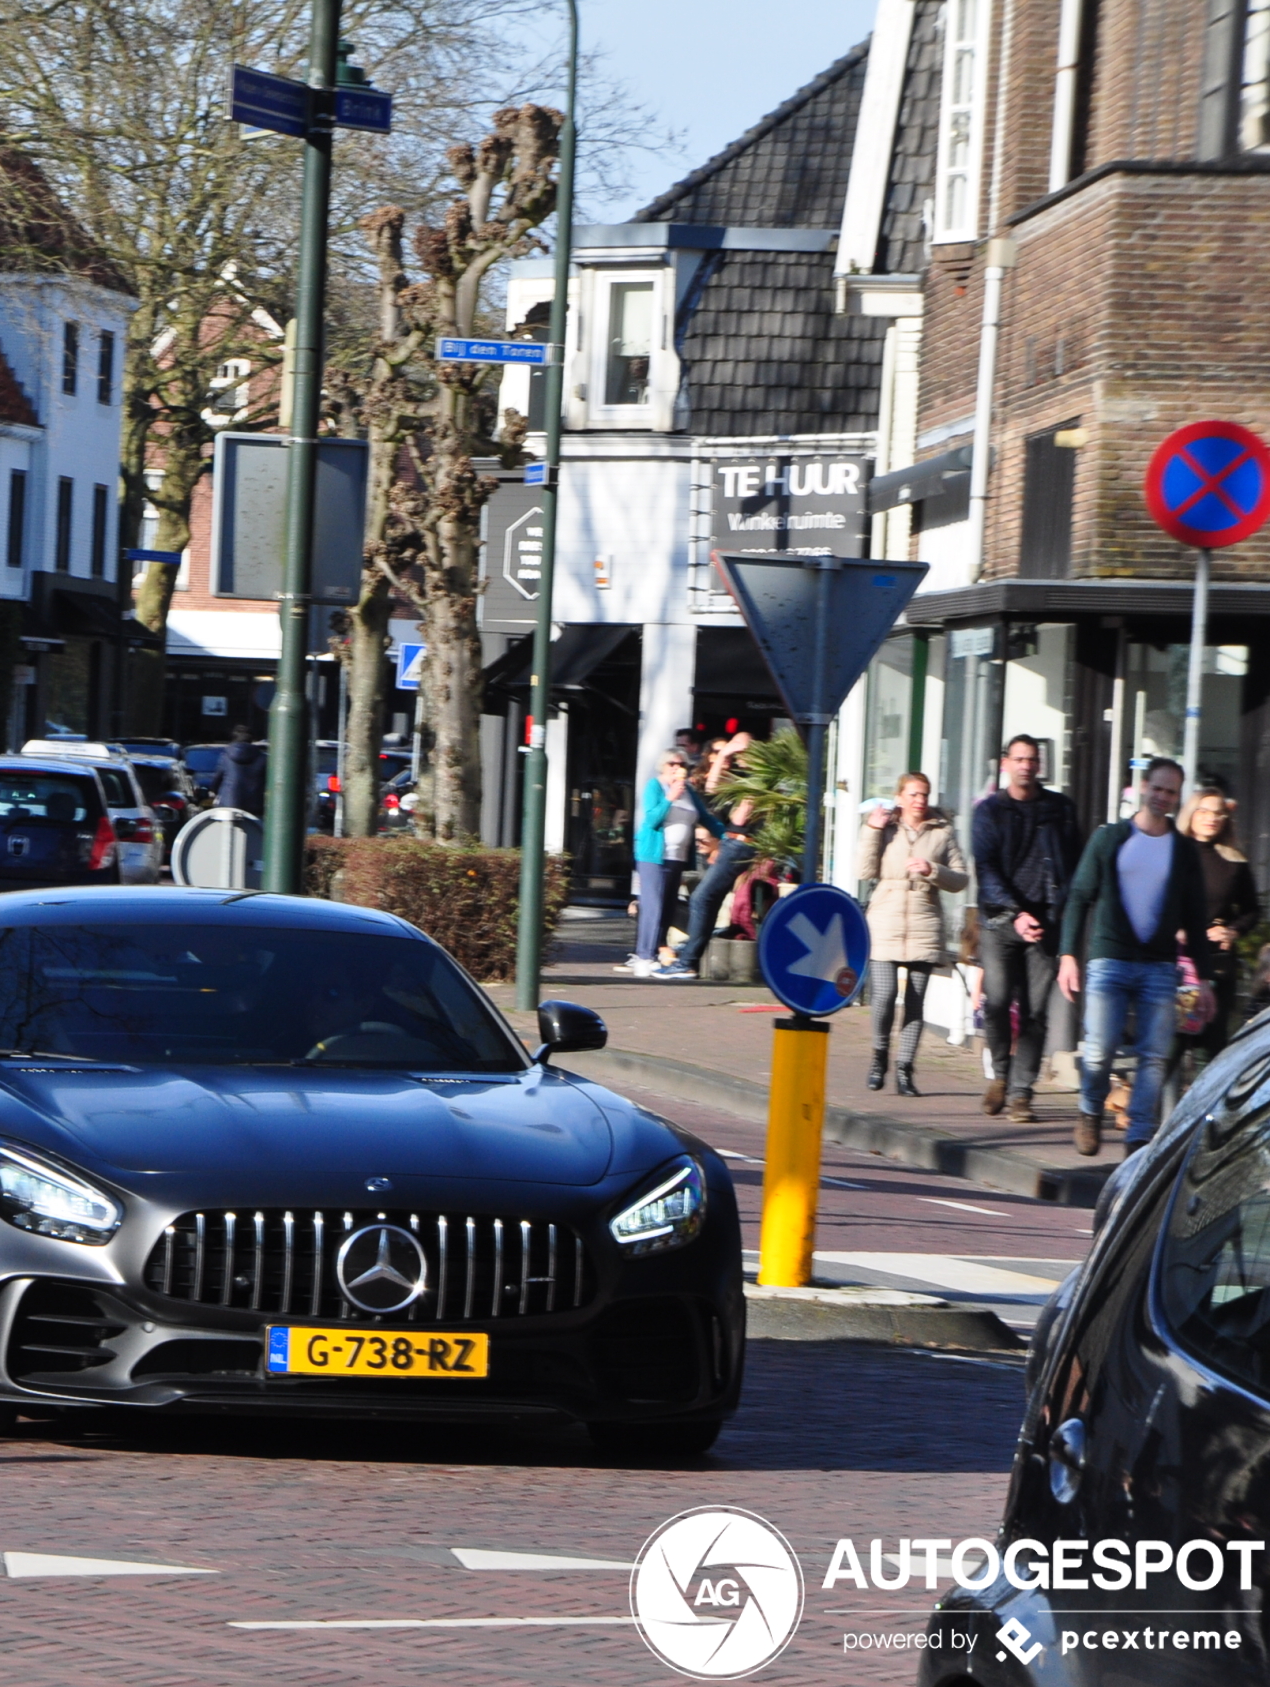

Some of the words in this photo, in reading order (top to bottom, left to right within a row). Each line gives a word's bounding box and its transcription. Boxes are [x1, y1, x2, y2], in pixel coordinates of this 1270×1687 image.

[444, 342, 467, 357] Bij
[470, 344, 497, 356] den
[717, 465, 761, 498] TE
[765, 463, 860, 497] HUUR
[727, 511, 847, 531] Winkelruimte
[307, 1335, 475, 1372] G-738-RZ
